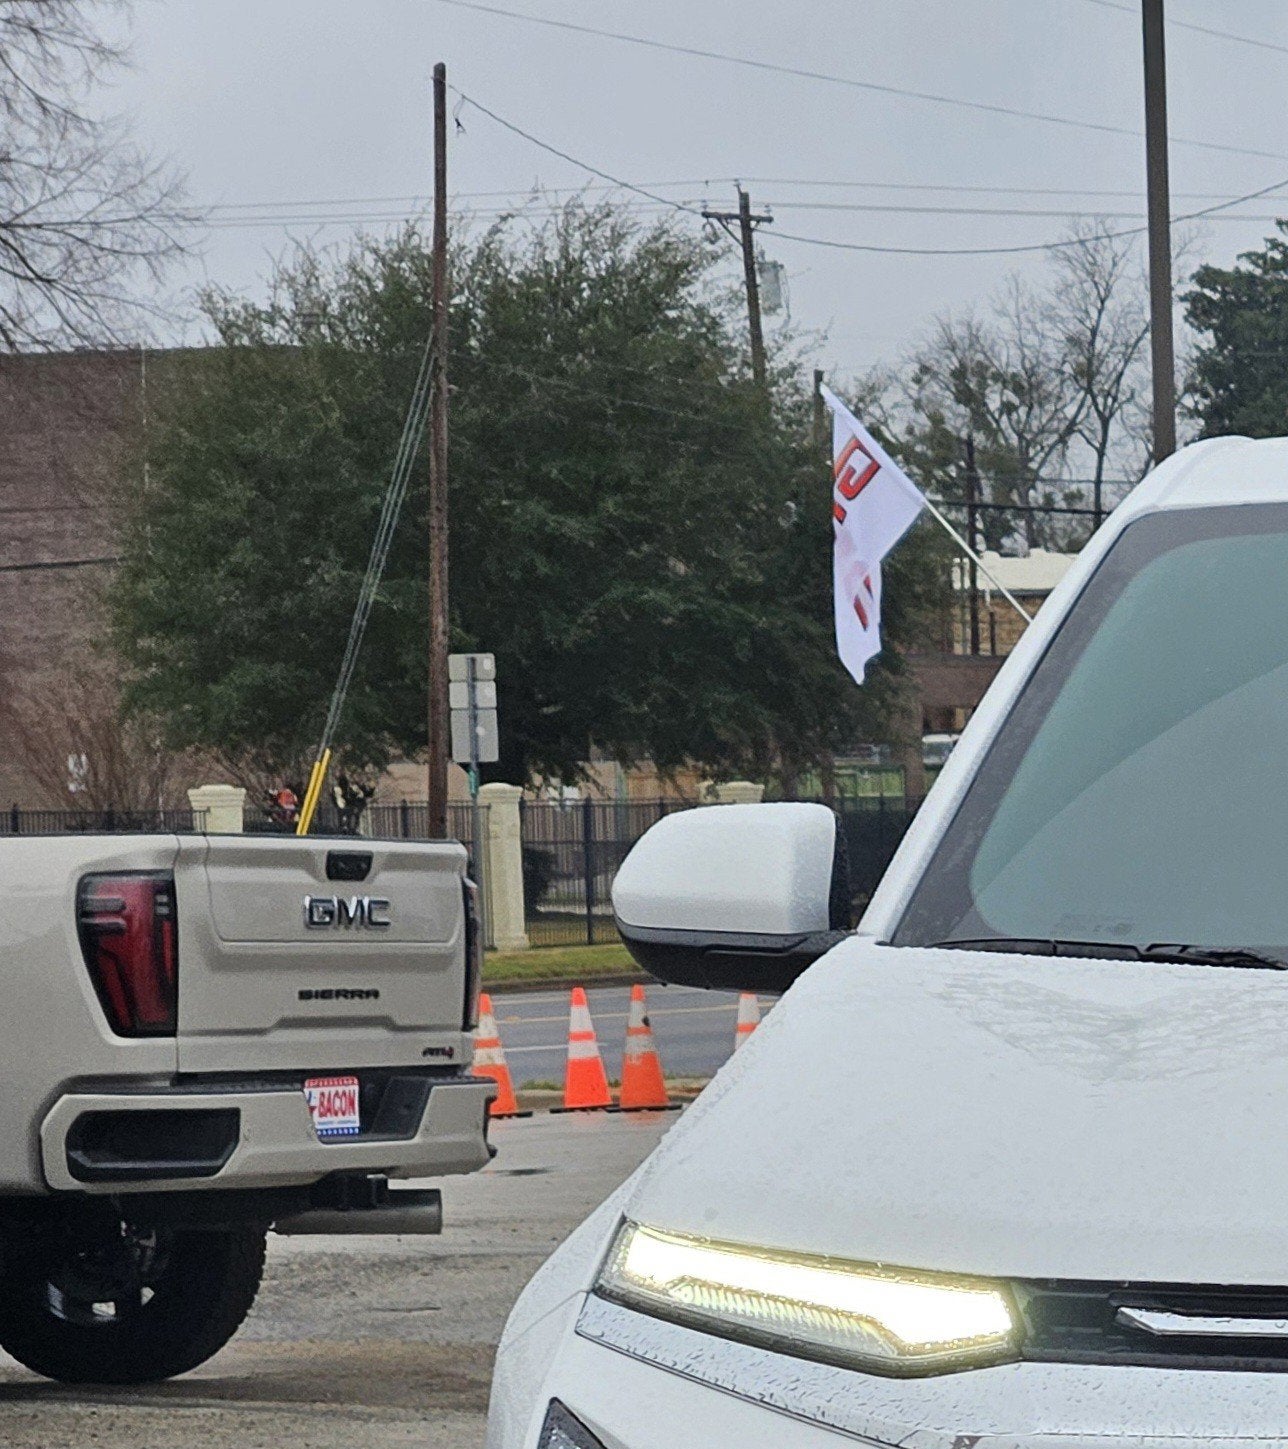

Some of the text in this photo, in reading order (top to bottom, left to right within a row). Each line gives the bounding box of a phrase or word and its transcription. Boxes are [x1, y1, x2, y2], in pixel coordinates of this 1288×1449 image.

[304, 895, 391, 930] GMC
[298, 988, 380, 1000] SIERRA
[318, 1089, 356, 1118] BACON
